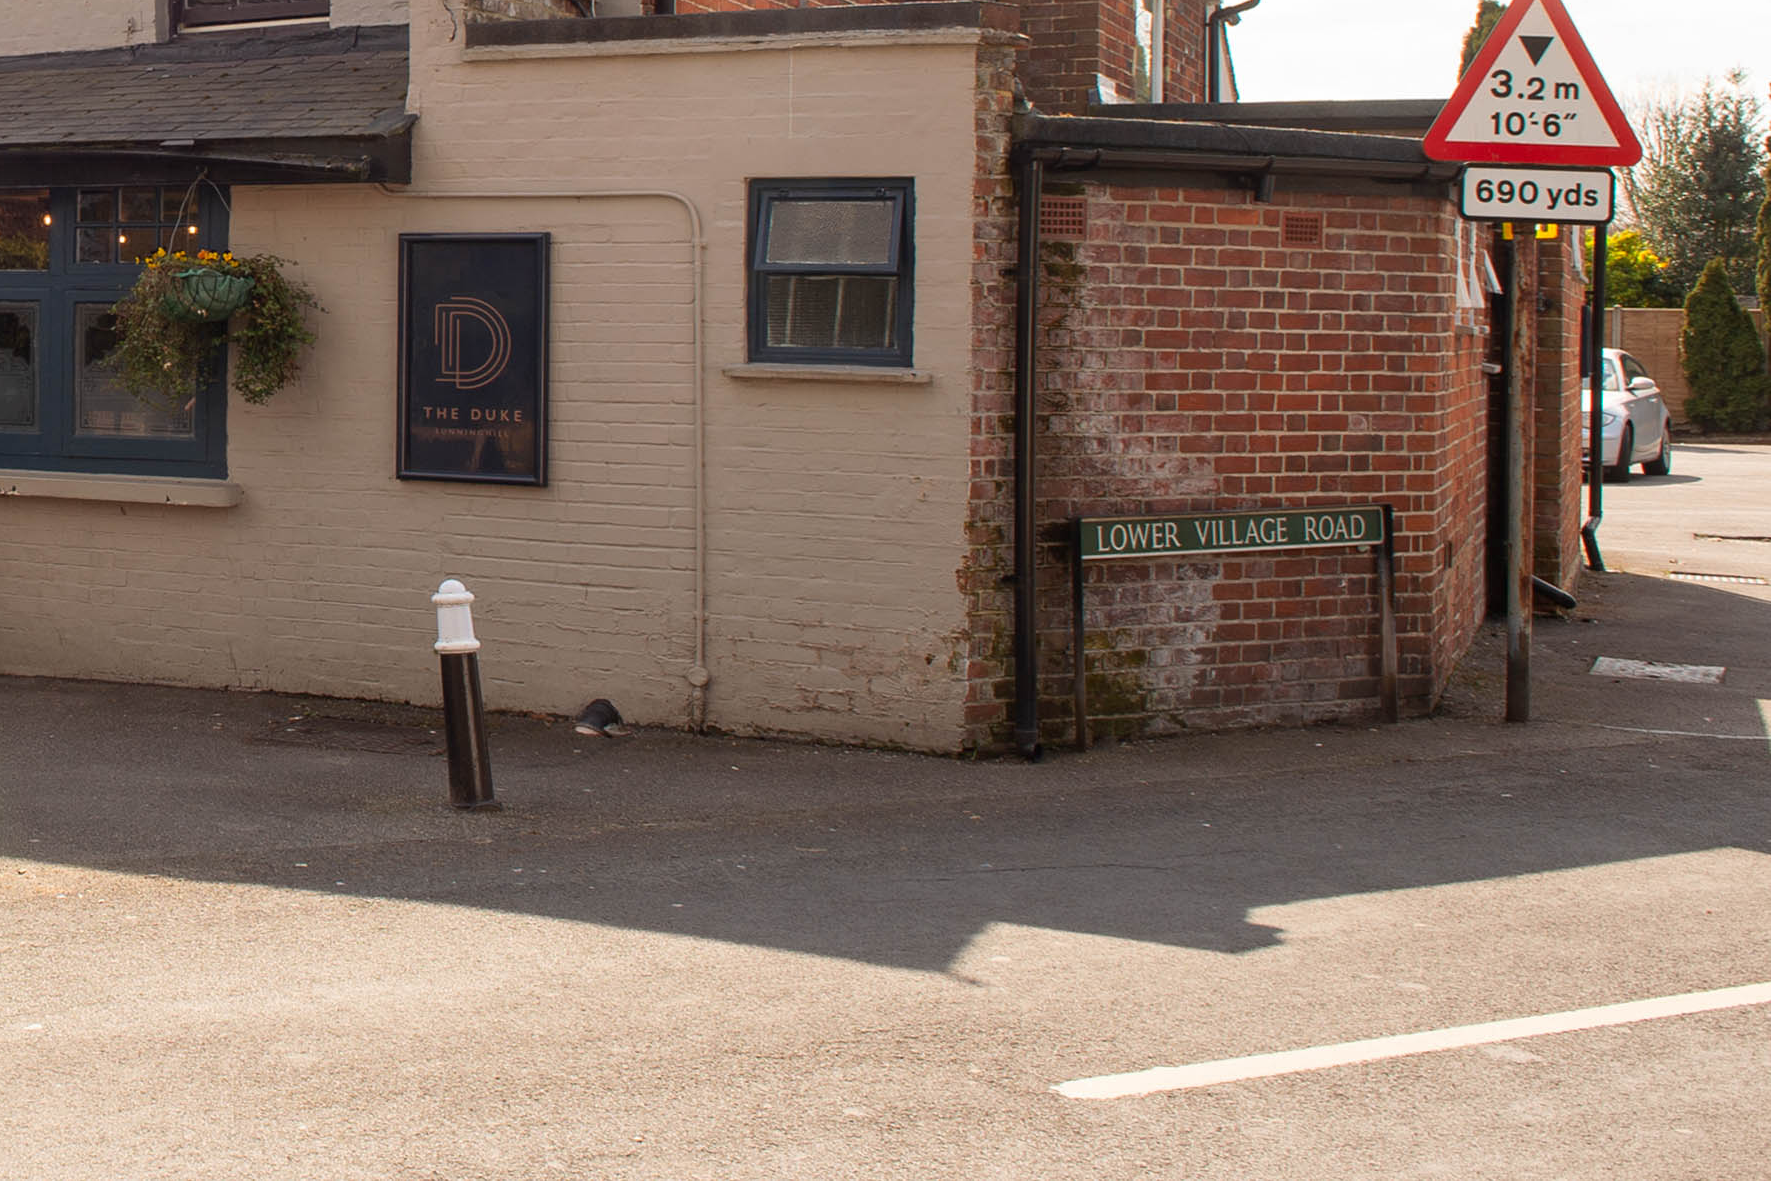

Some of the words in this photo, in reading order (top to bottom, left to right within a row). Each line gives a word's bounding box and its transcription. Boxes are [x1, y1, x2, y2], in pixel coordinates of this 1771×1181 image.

[1490, 69, 1546, 101] 3.2
[1554, 81, 1580, 100] m
[1476, 179, 1539, 205] 690
[1547, 182, 1599, 210] yds
[422, 406, 460, 420] THE
[470, 408, 523, 423] DUKE
[1096, 521, 1182, 553] LOWER
[1194, 517, 1289, 547] VILLAGE
[1304, 514, 1367, 542] ROAD
